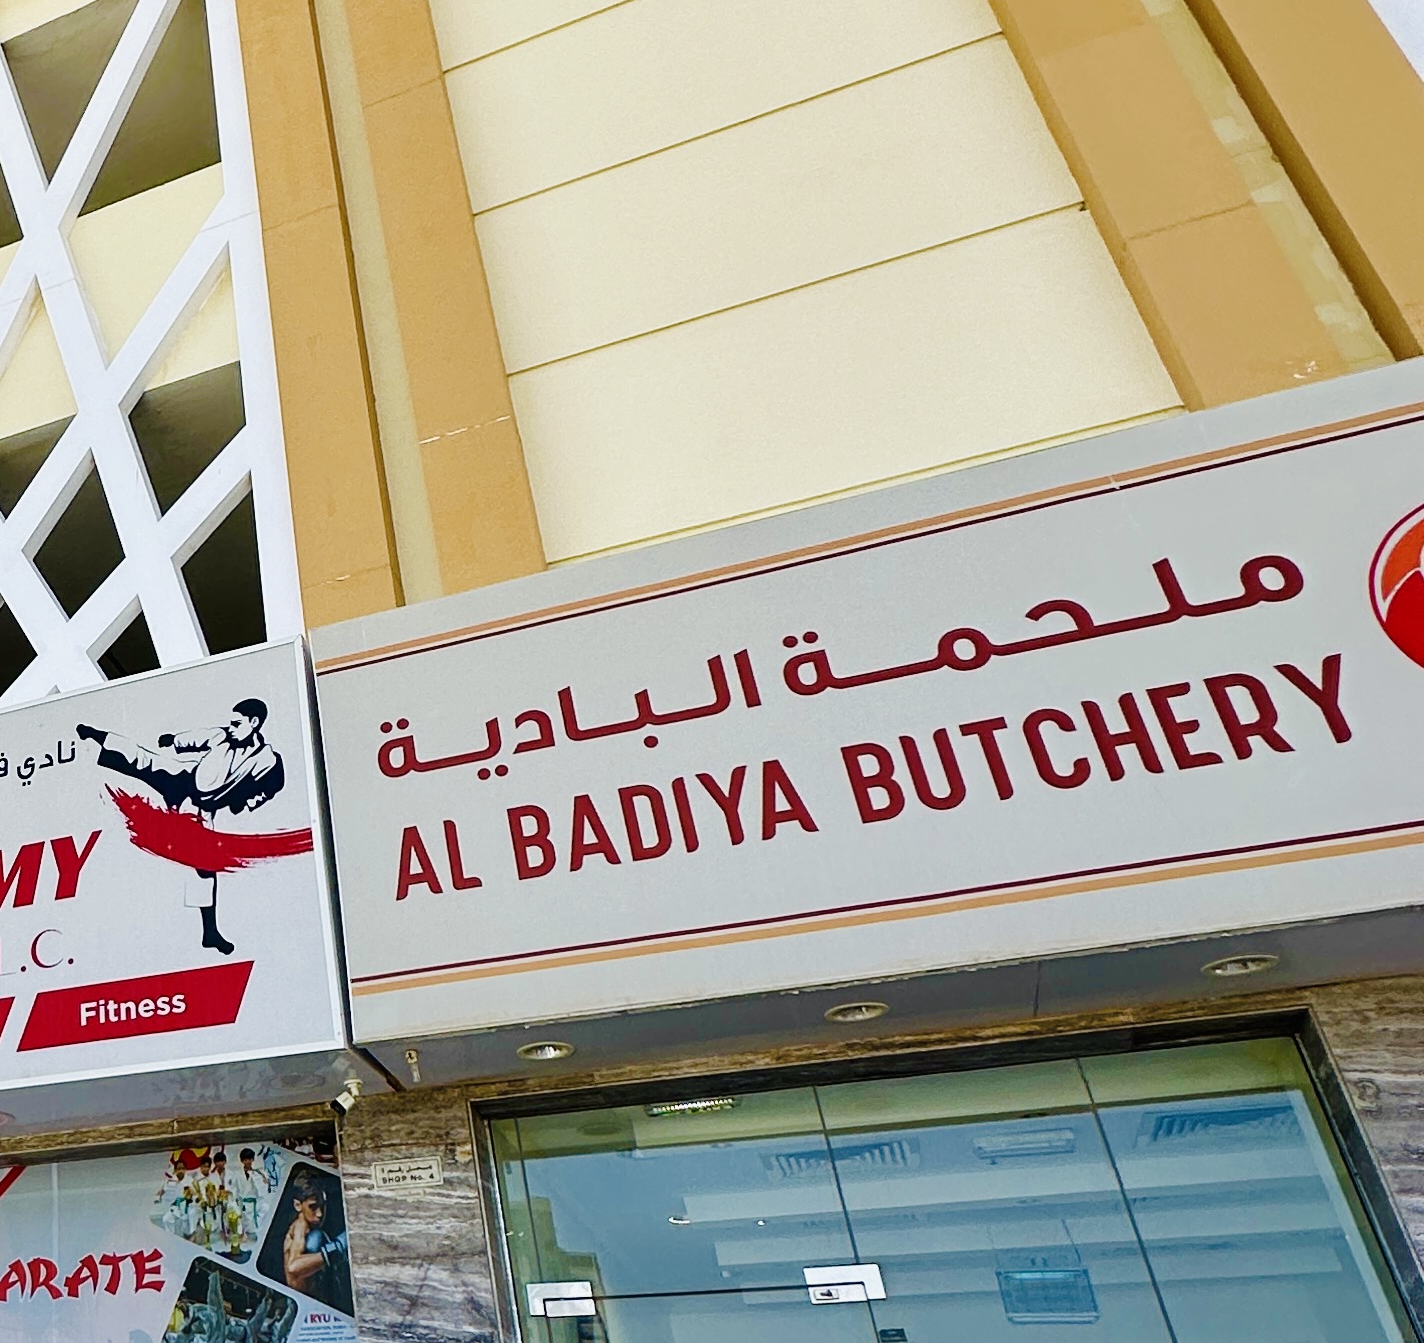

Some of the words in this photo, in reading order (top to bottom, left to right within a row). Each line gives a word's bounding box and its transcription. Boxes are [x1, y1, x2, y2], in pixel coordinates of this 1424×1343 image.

[782, 555, 1304, 696] ملحمة
[377, 649, 762, 780] البادية
[16, 739, 77, 786] نادي
[396, 820, 482, 901] AL
[506, 759, 819, 881] BADIYA
[840, 653, 1352, 824] BUTCHERY
[79, 992, 187, 1027] Fitness
[382, 1175, 407, 1184] SHOP
